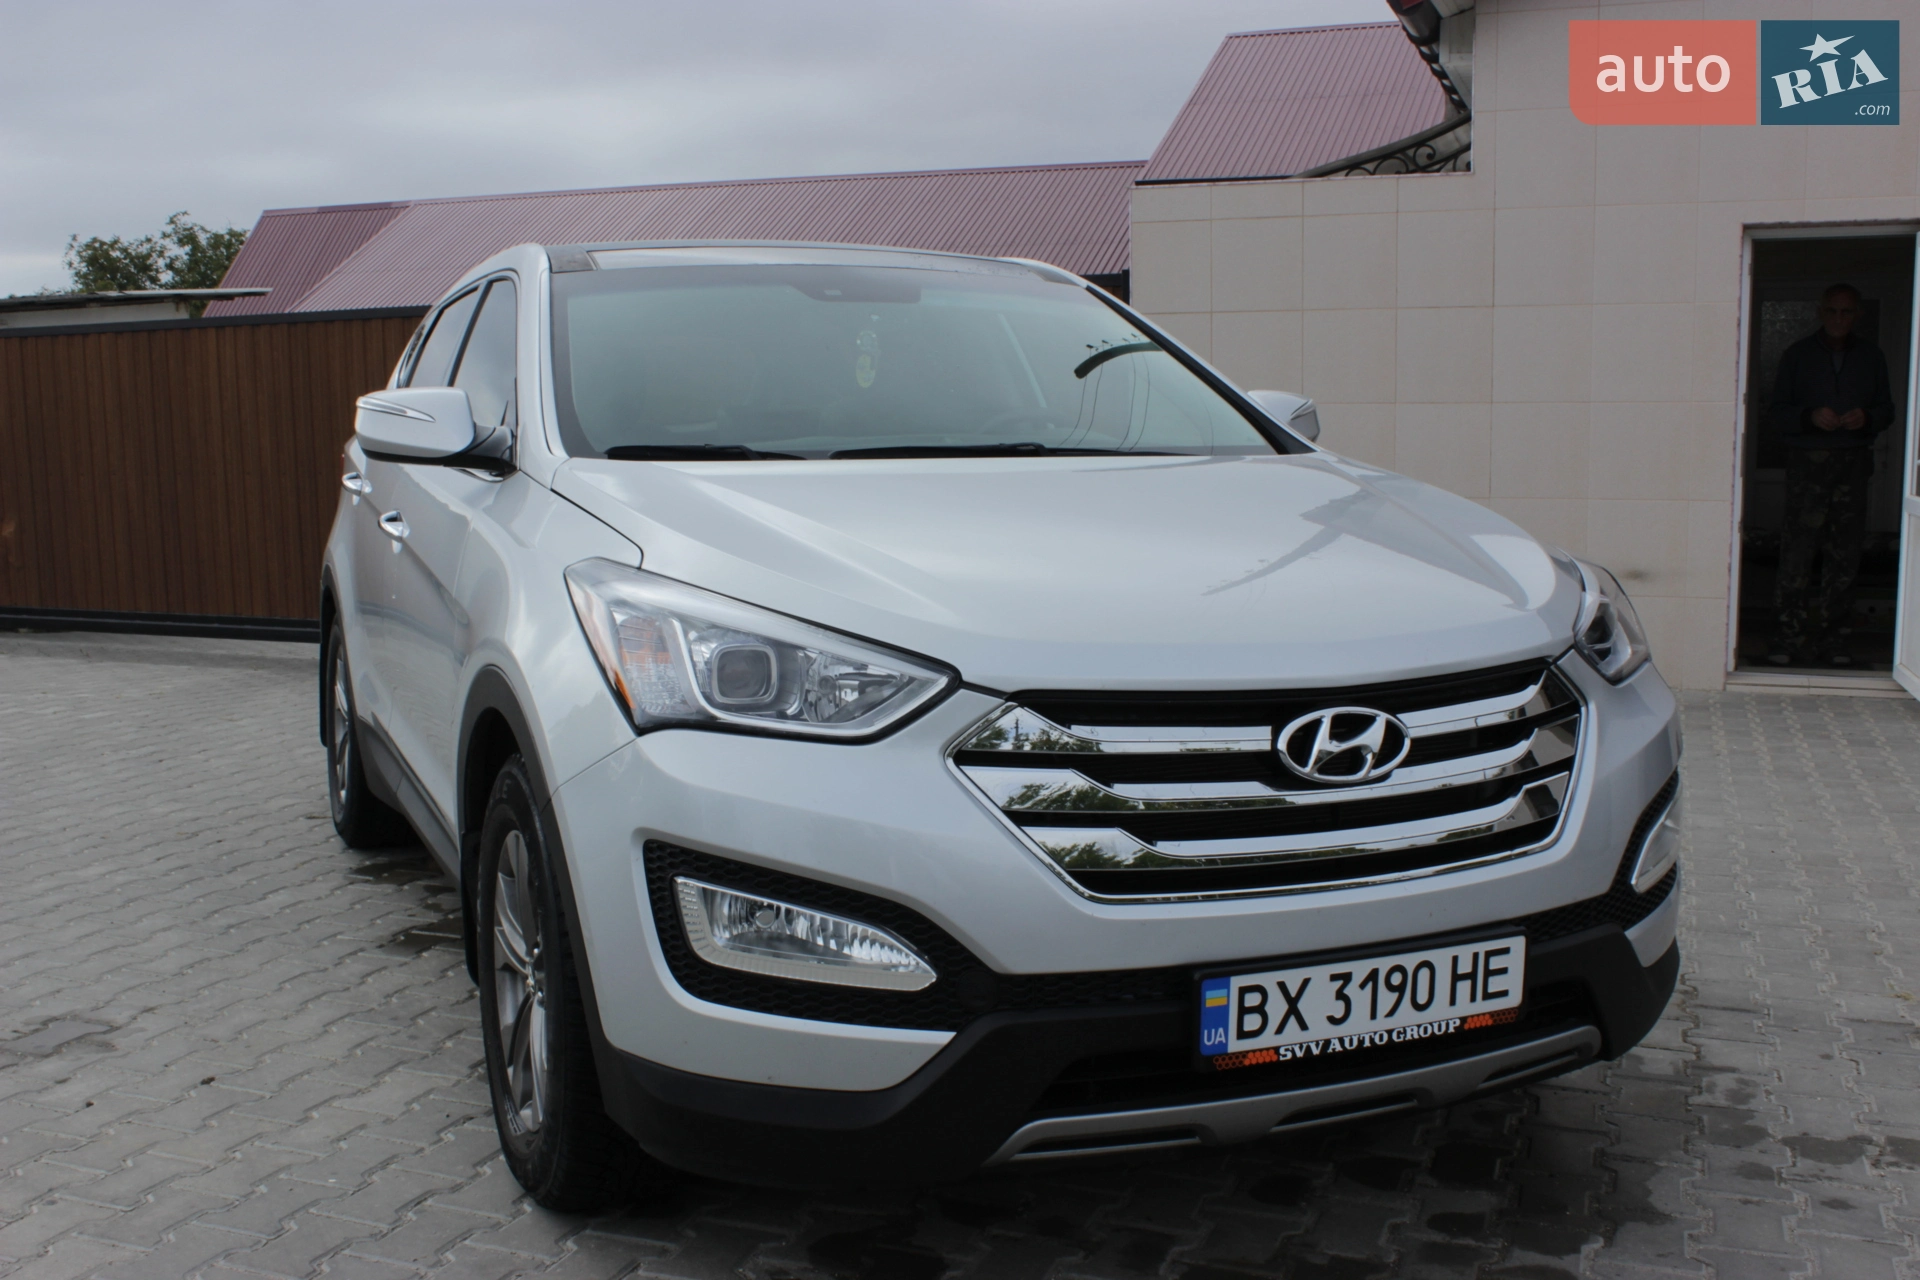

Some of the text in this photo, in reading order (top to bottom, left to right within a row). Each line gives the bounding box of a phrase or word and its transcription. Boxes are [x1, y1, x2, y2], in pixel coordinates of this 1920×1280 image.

[1236, 946, 1511, 1041] BX 3190 HE
[1203, 1027, 1227, 1046] UA
[1279, 1018, 1461, 1061] SVV AUTO GROUP
